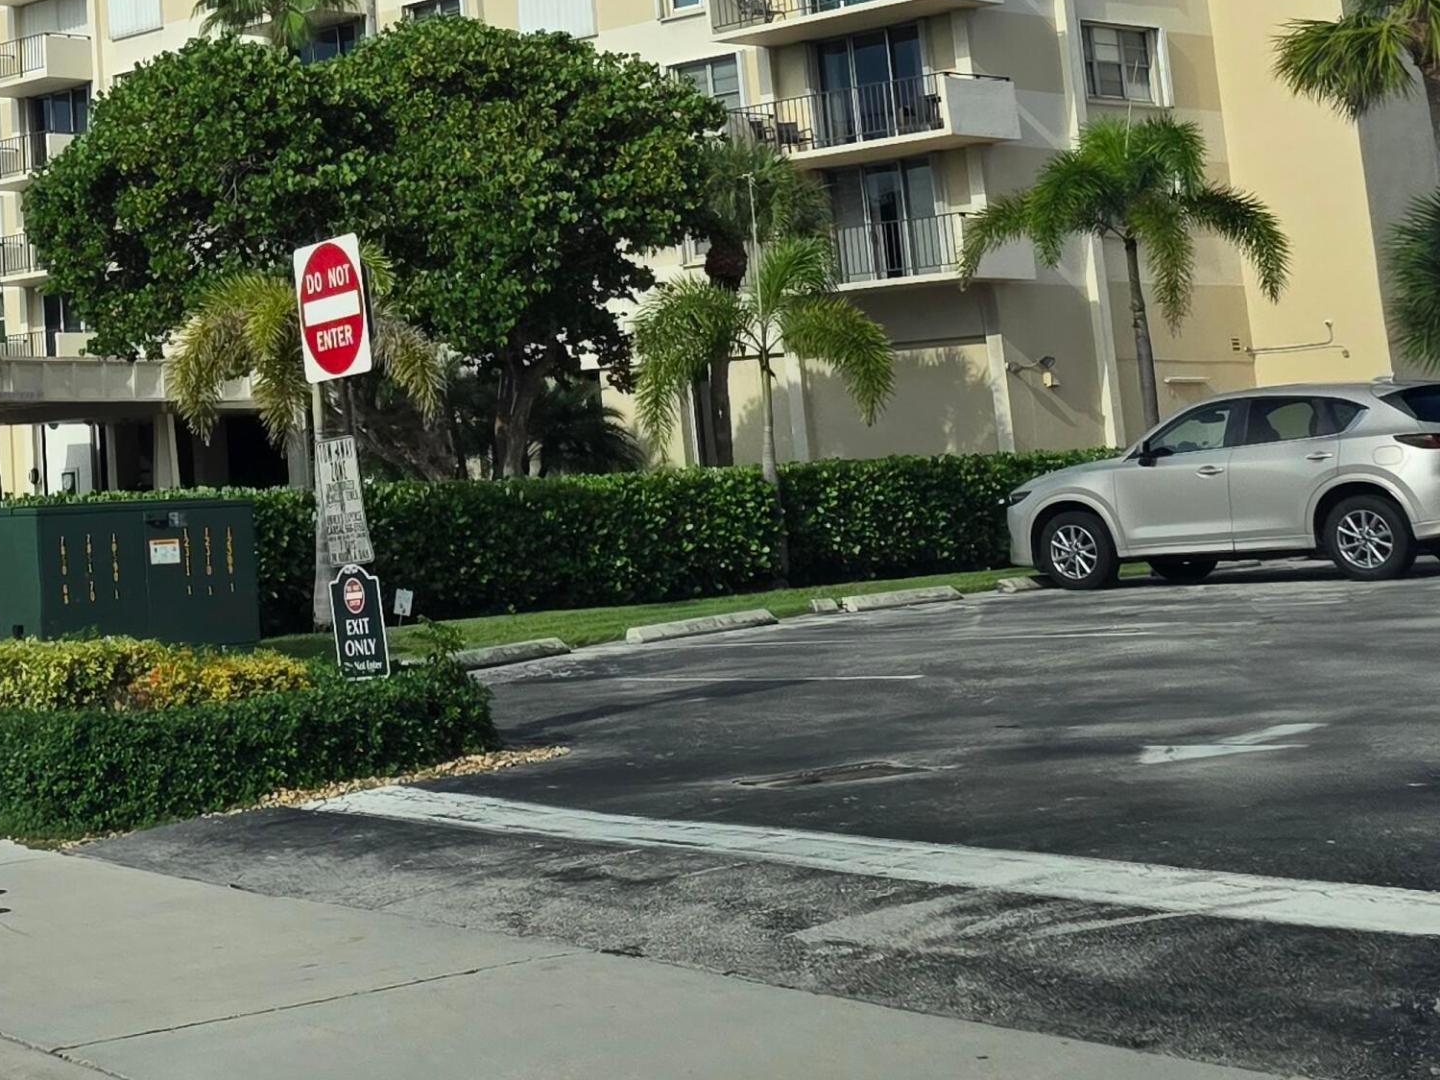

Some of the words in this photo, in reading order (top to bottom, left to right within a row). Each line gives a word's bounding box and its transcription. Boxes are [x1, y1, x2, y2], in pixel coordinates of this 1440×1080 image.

[306, 272, 322, 294] DO
[328, 264, 350, 288] NOT
[316, 324, 353, 352] ENTER
[346, 617, 370, 636] EXIT
[344, 638, 377, 657] ONLY
